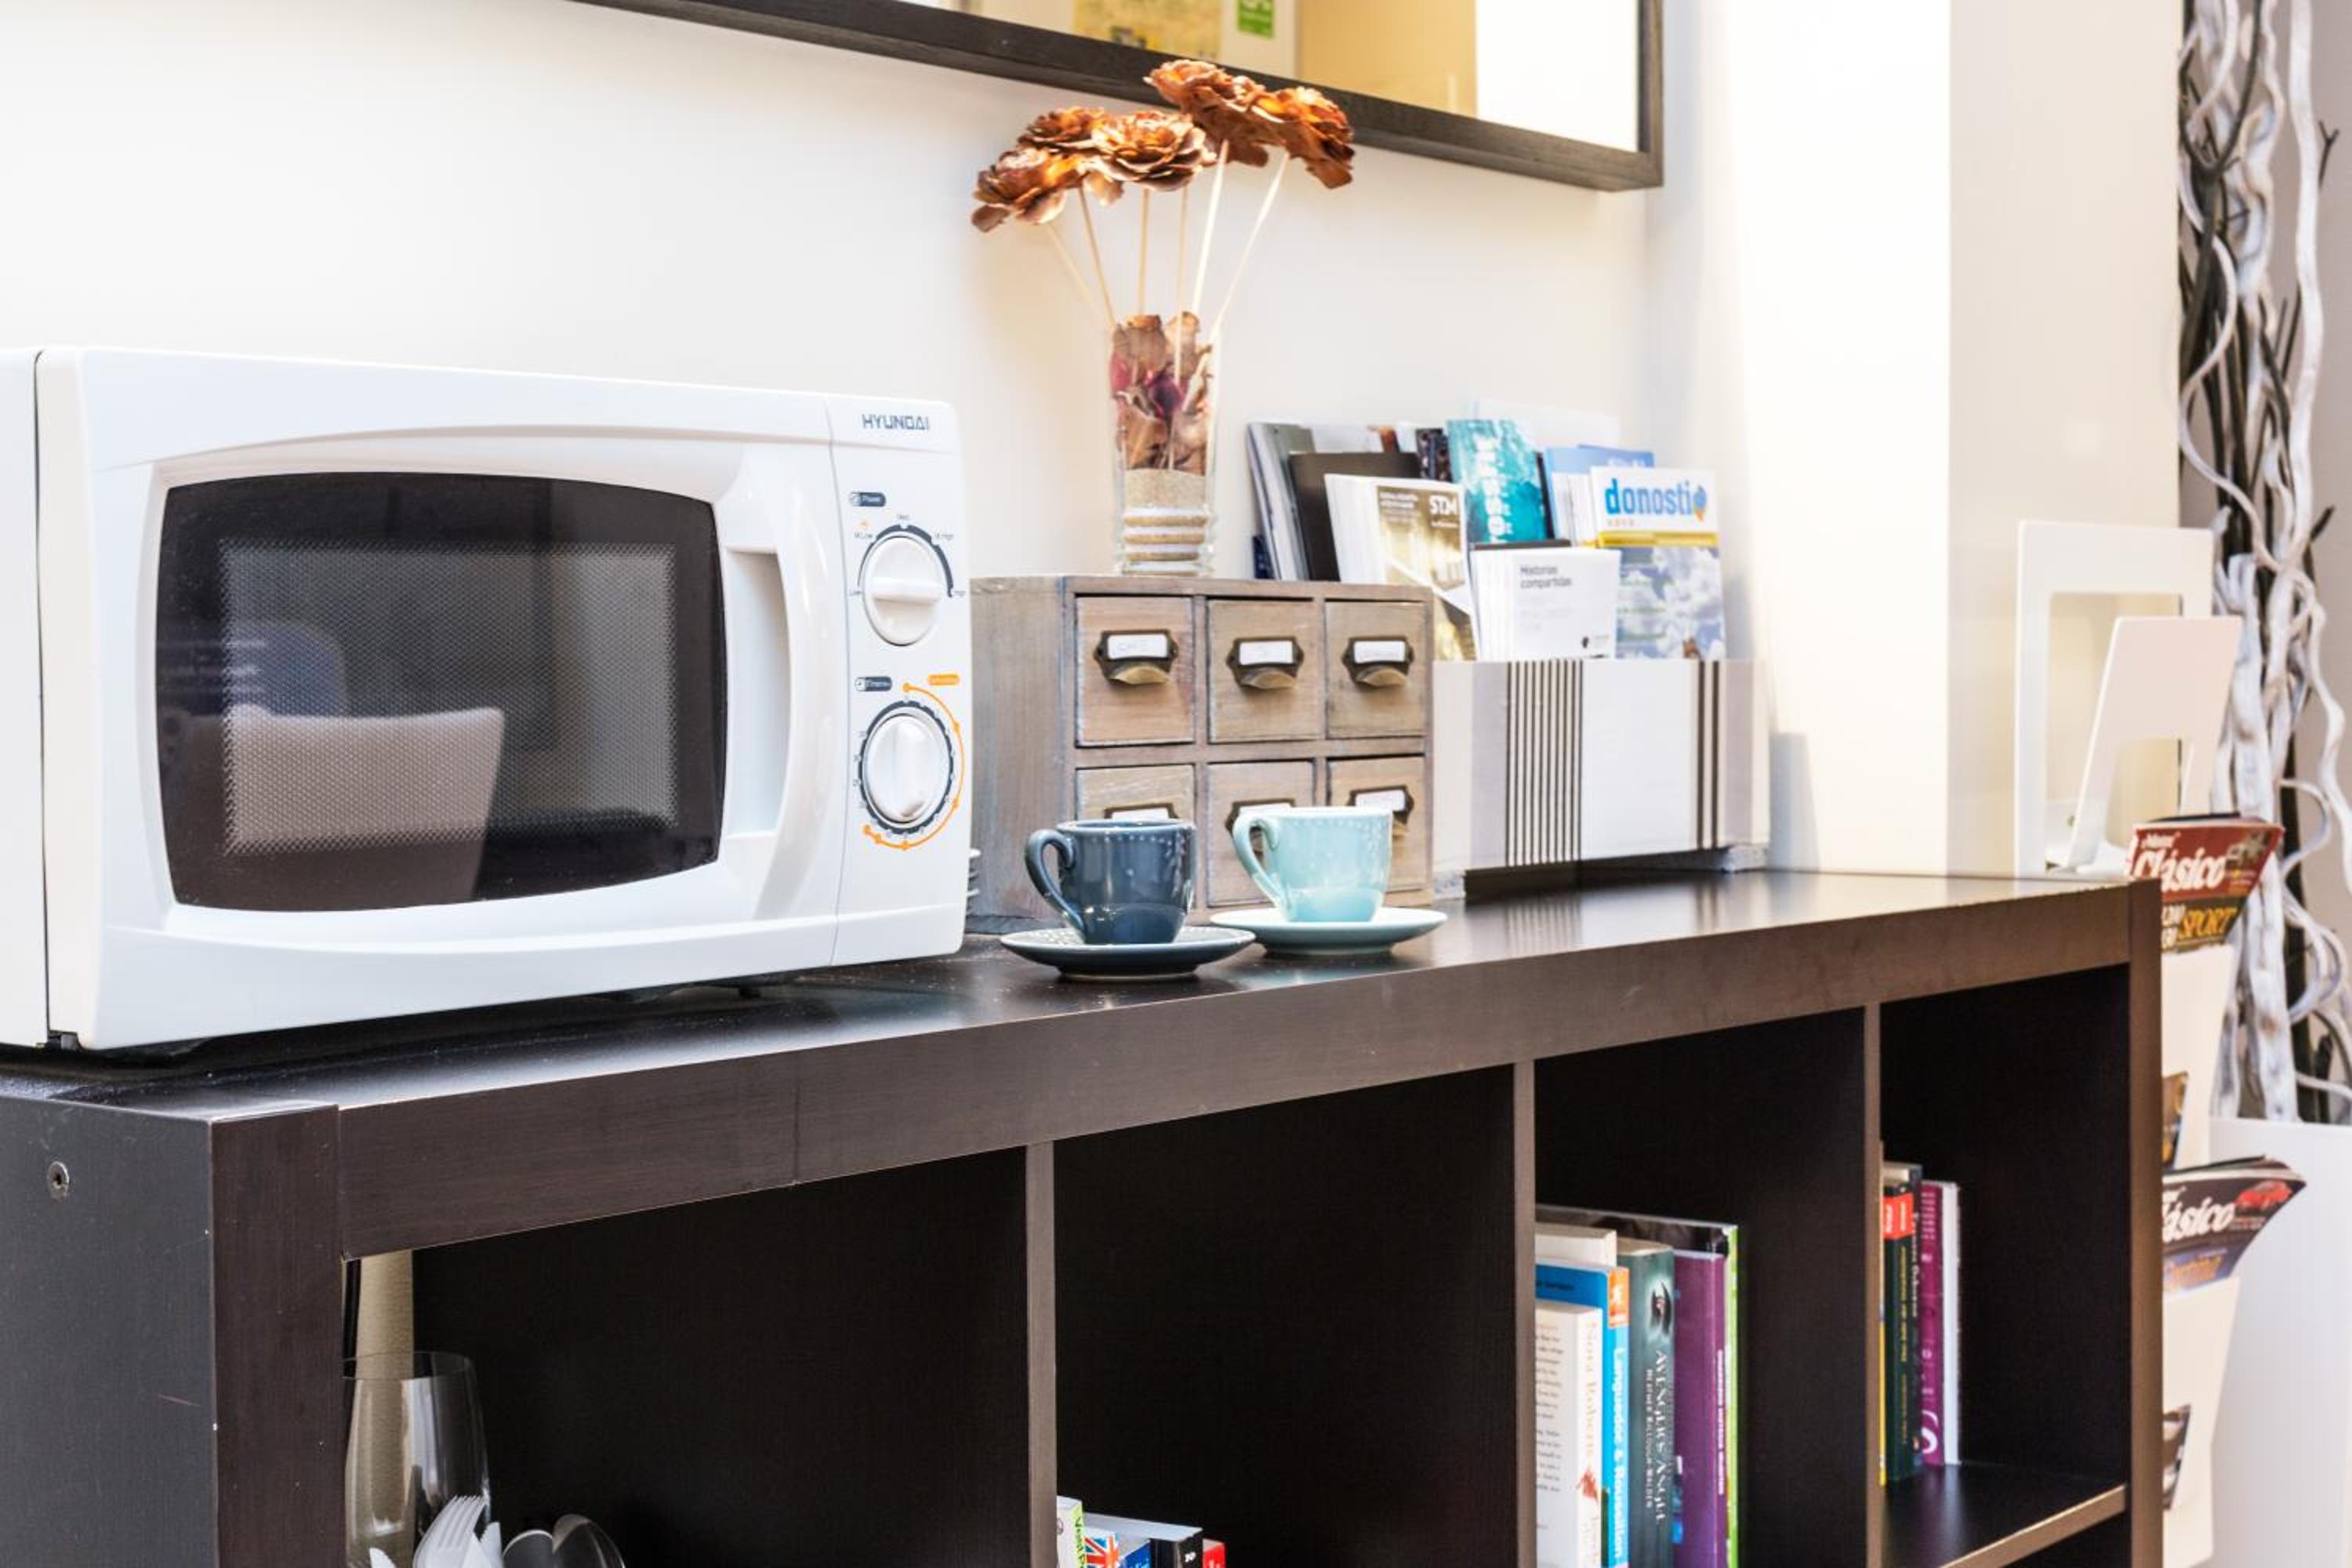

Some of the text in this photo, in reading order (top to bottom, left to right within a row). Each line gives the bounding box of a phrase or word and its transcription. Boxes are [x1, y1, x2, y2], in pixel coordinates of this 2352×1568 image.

[862, 413, 931, 430] HYUNDAI
[1519, 564, 1558, 575] Historias
[1519, 577, 1573, 590] compartidas
[2177, 906, 2238, 941] SPORT
[1611, 1346, 1628, 1559] Languedoc & Roussillon
